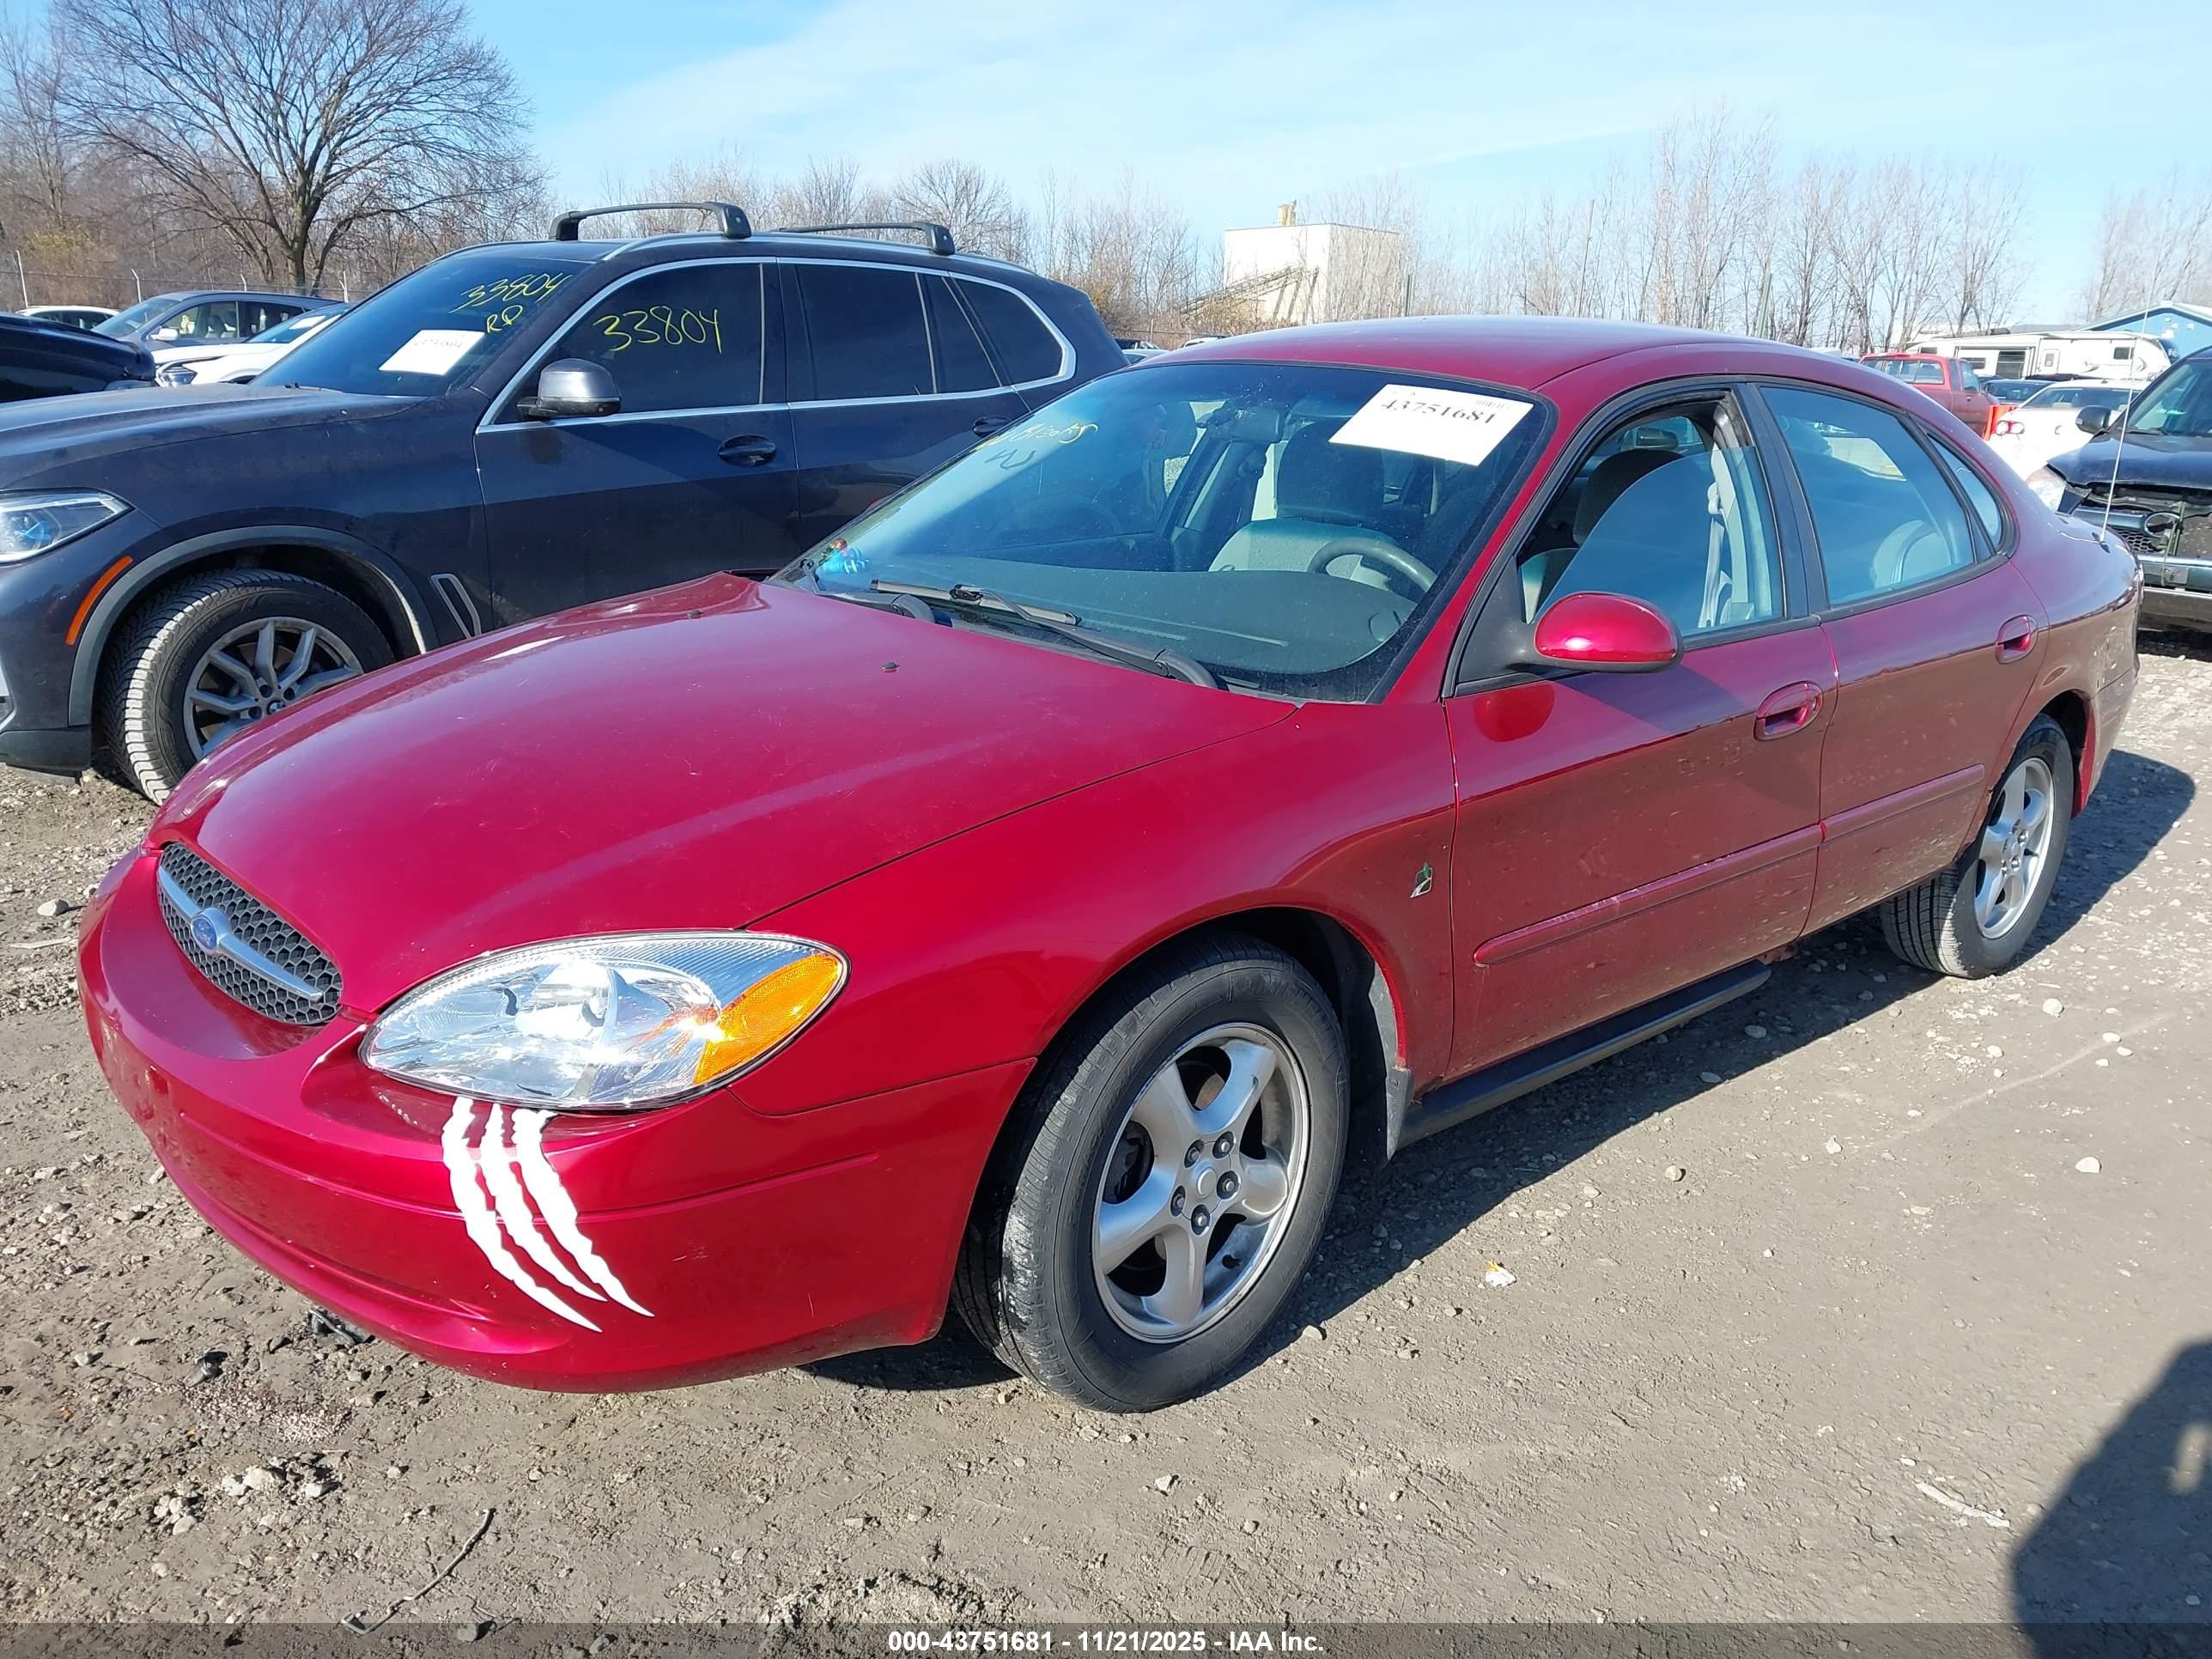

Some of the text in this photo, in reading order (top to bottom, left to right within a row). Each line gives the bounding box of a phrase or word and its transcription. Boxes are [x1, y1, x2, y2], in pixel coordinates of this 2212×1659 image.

[447, 272, 574, 314] 33804
[592, 305, 722, 355] 33804
[1380, 398, 1497, 424] 43751681
